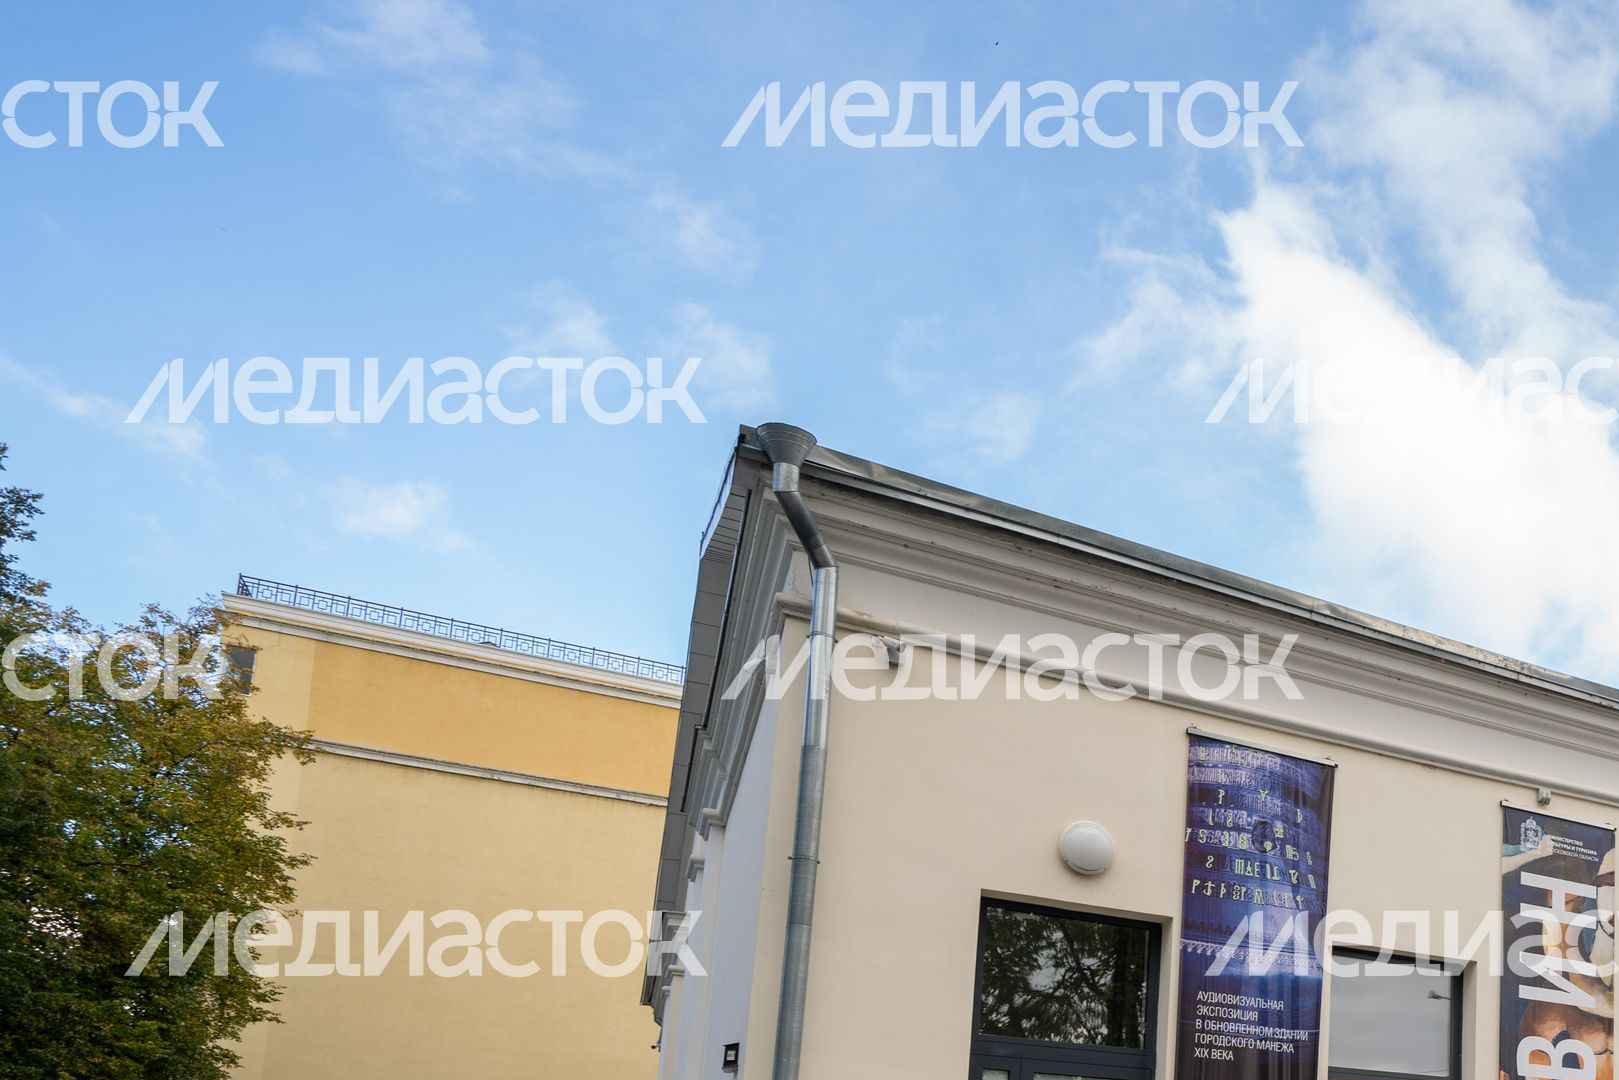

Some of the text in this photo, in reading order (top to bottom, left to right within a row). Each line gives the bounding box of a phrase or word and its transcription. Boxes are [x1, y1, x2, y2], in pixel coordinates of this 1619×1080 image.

[1549, 848, 1578, 858] ОСКОВСКОЙ
[1196, 990, 1284, 1011] АУДИОВИЗУАЛЬНАЯ
[1196, 1005, 1258, 1021] ЭКСПОЗИЦИЯ
[1195, 1019, 1308, 1041] В ОБНОВЛЕННОМ ЗДАНИИ
[1194, 1033, 1295, 1053] ГОРОДСКОГО МАНЕЖА
[1211, 1049, 1234, 1061] ВЕКА
